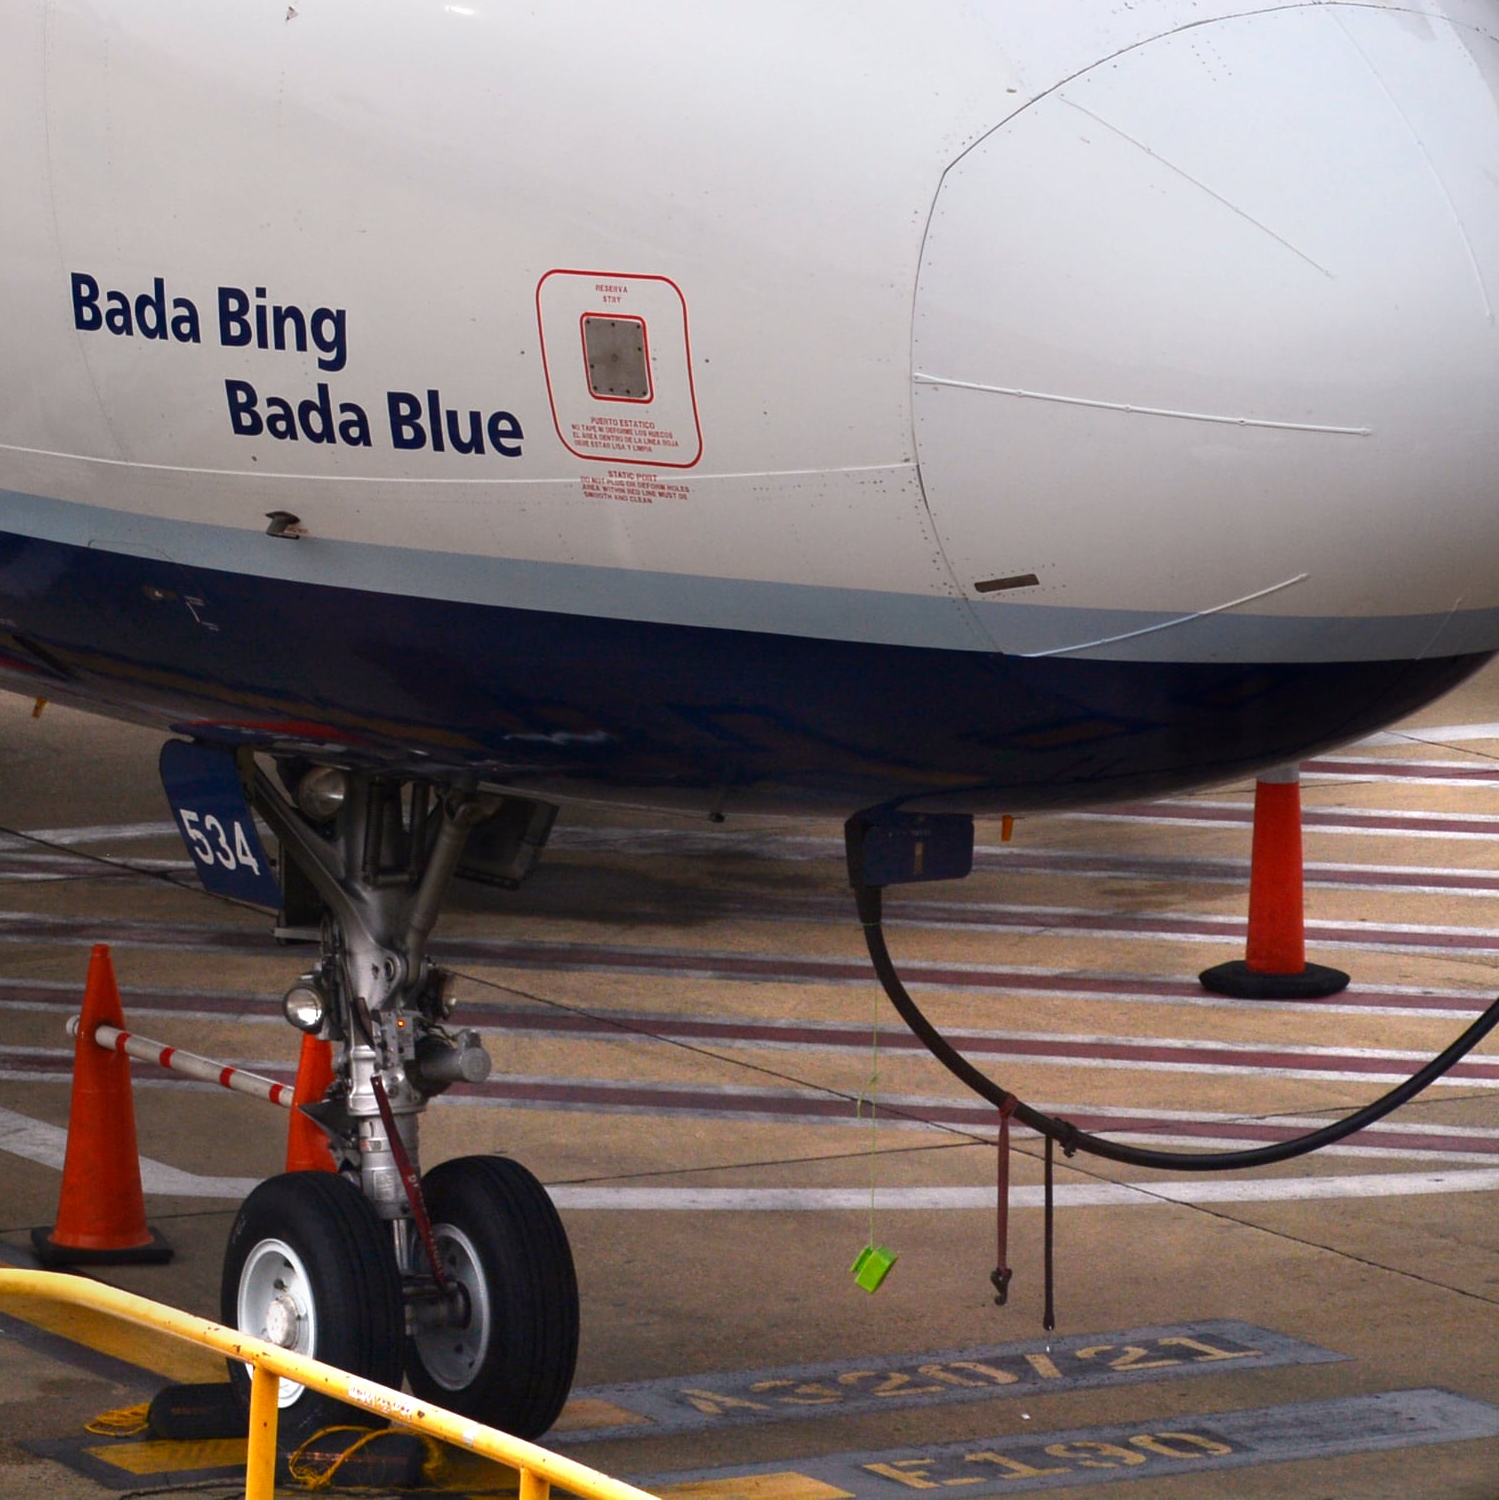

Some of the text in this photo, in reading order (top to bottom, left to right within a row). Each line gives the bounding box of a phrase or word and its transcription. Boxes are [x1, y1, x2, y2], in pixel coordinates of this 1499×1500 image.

[70, 272, 348, 371] Bada Bing
[224, 379, 524, 457] Bada Blue
[619, 419, 655, 430] ESTATICO
[608, 470, 658, 482] STATIC PORT
[179, 808, 260, 877] 534
[682, 1333, 1264, 1415] A320/21
[861, 1431, 1234, 1491] E190
